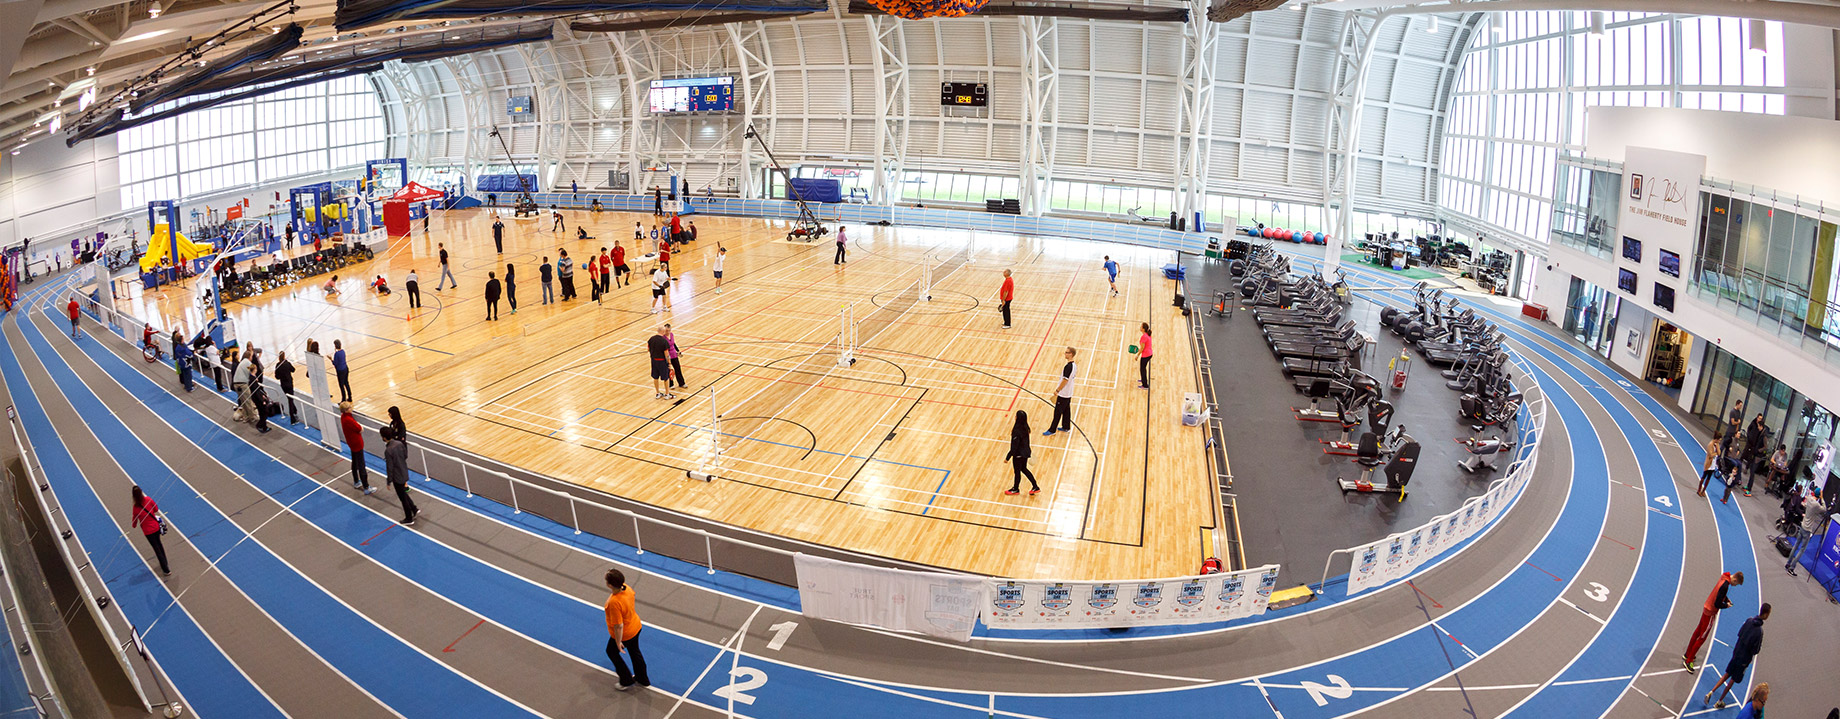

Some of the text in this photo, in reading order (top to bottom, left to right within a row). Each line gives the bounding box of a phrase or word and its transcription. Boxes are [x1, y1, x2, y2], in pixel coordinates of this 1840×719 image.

[1643, 209, 1662, 220] FLAHERTY
[1662, 214, 1673, 223] FIELD
[1674, 216, 1687, 227] HOUSE
[1651, 428, 1667, 438] 5
[1654, 495, 1673, 508] 4
[1224, 581, 1242, 589] SPORTS
[1262, 576, 1277, 584] SPORT
[1583, 581, 1610, 603] 3
[766, 620, 799, 651] 1
[712, 666, 768, 706] 2
[1300, 674, 1353, 707] 2
